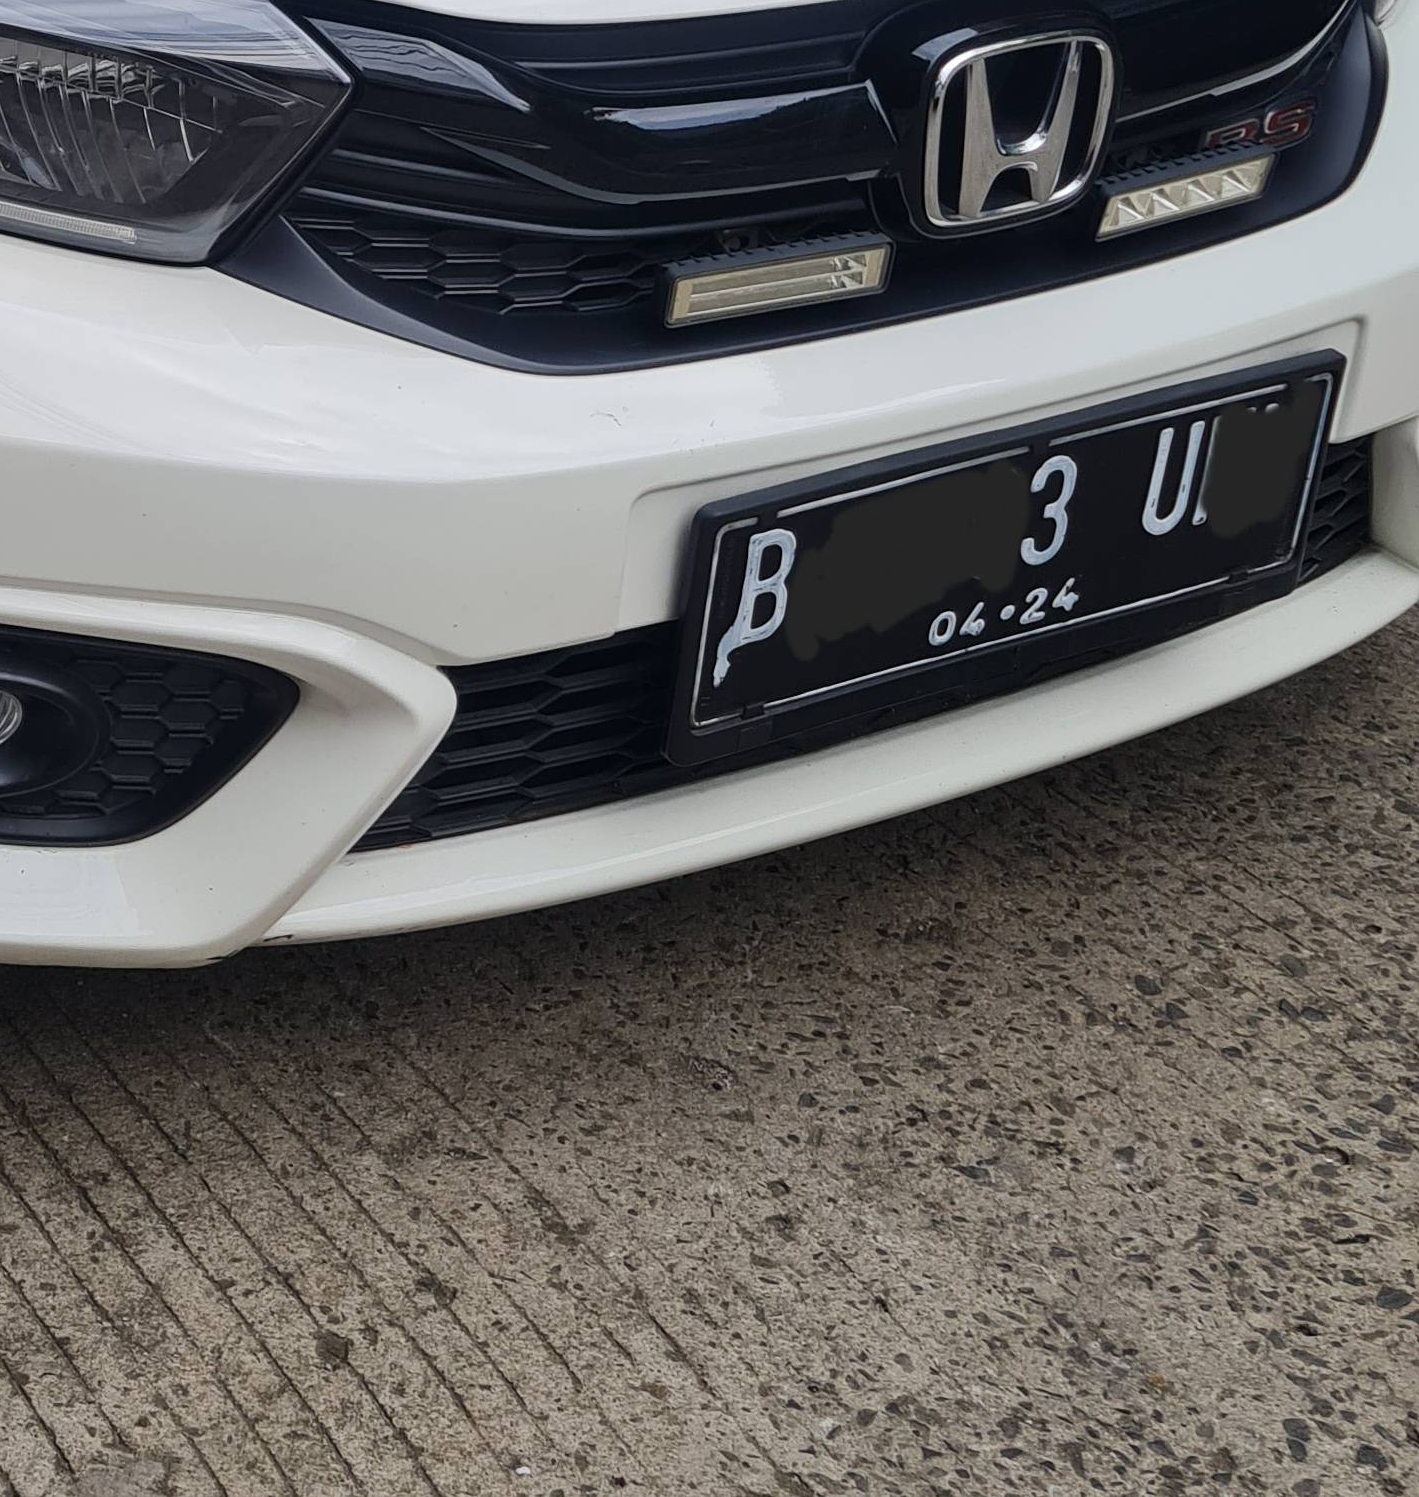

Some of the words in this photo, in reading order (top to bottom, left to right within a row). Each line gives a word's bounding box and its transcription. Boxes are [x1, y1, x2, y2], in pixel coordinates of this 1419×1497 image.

[1204, 102, 1317, 151] RS
[729, 528, 797, 653] B
[1141, 416, 1228, 536] U
